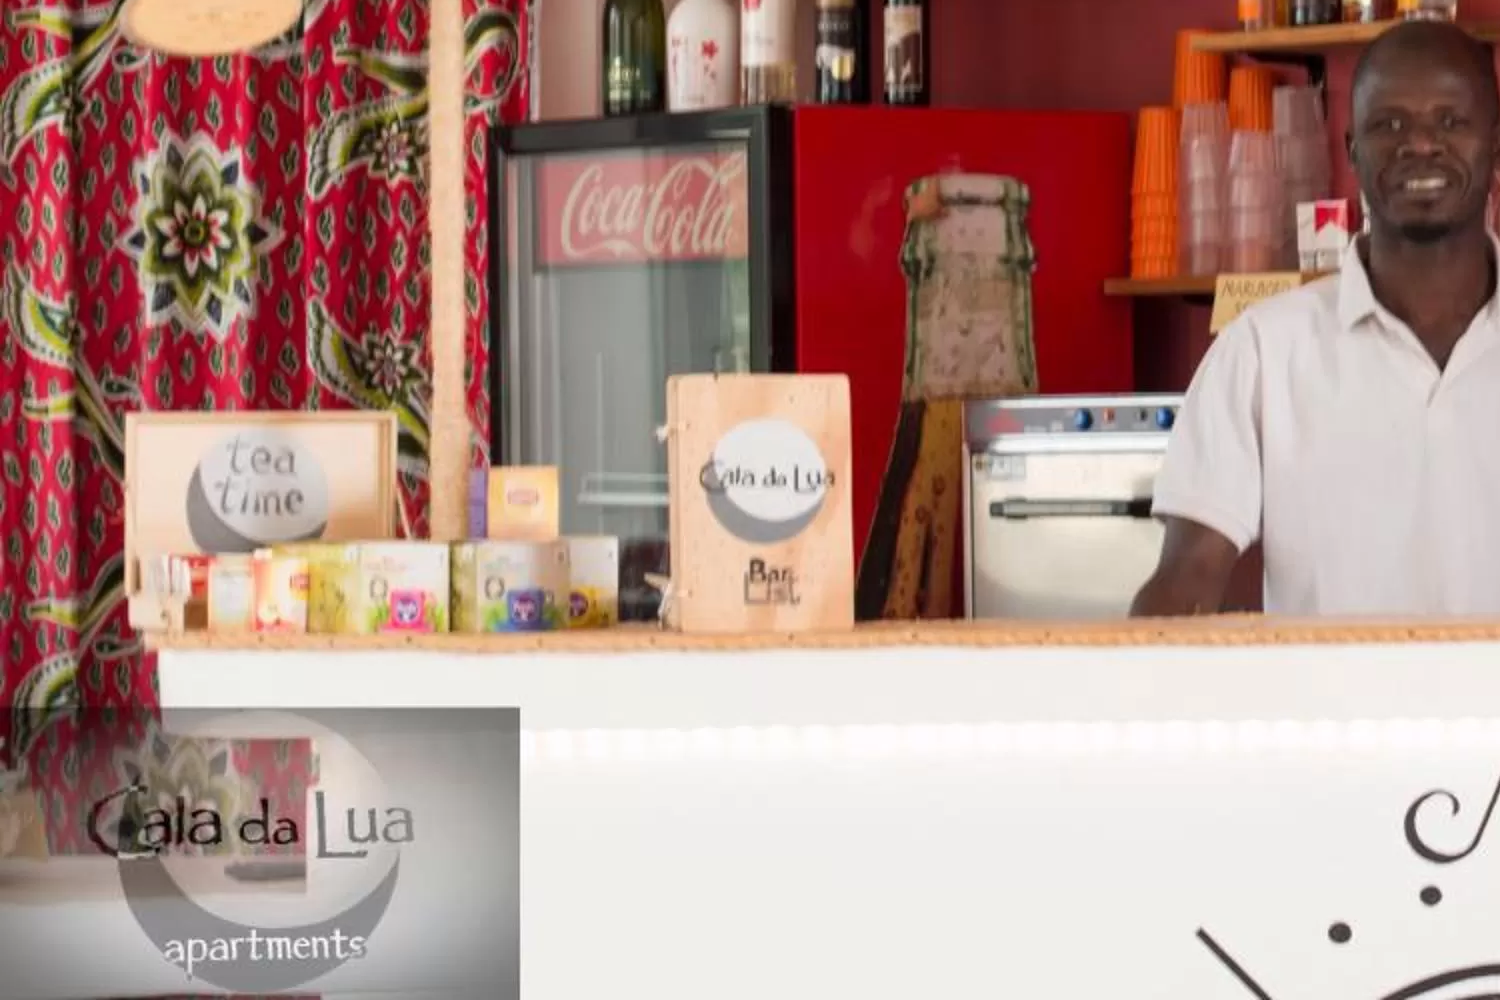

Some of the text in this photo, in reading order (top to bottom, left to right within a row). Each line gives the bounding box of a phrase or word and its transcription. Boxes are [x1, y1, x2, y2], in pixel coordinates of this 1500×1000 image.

[226, 434, 296, 475] tea
[699, 453, 836, 493] Cala da Lua
[214, 476, 304, 517] time
[749, 557, 789, 583] Bar
